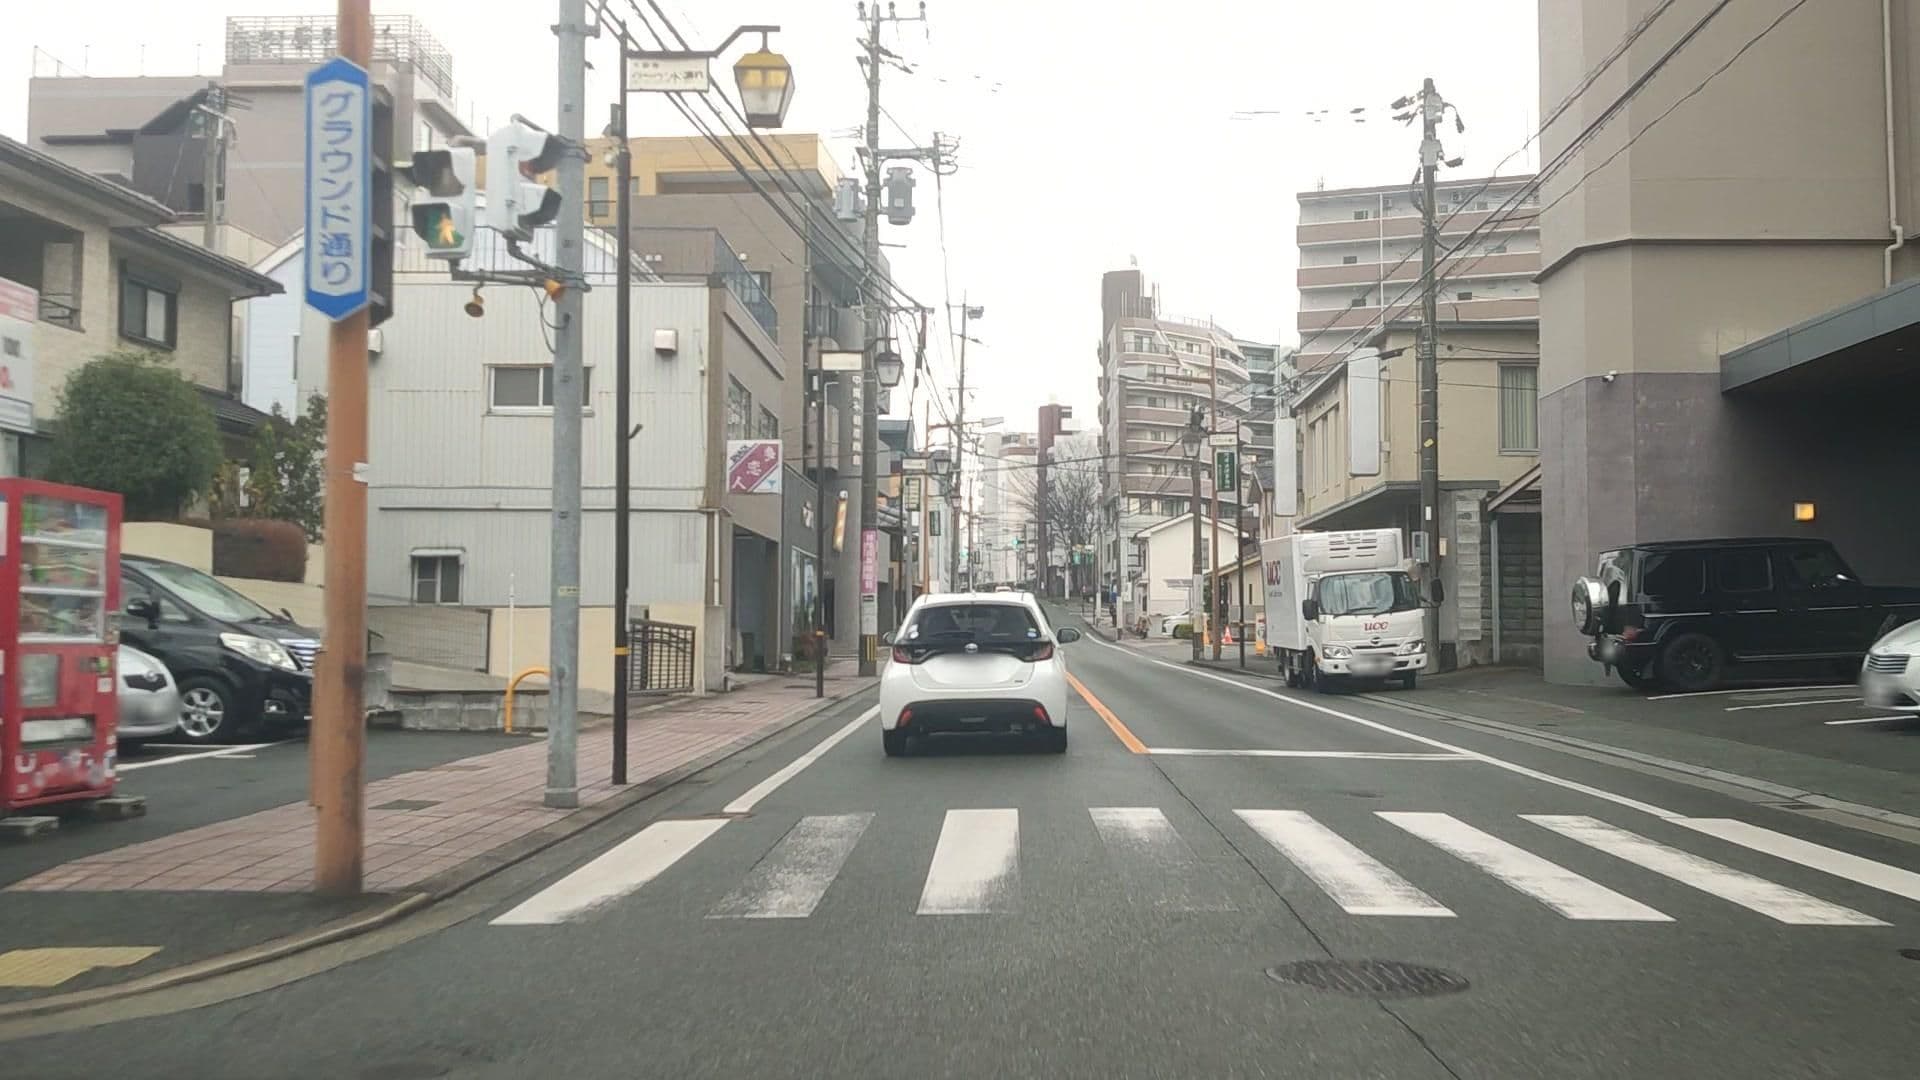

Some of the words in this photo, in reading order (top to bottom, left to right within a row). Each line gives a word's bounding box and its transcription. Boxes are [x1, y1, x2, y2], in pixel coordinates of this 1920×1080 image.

[319, 90, 354, 286] グラウンド通り
